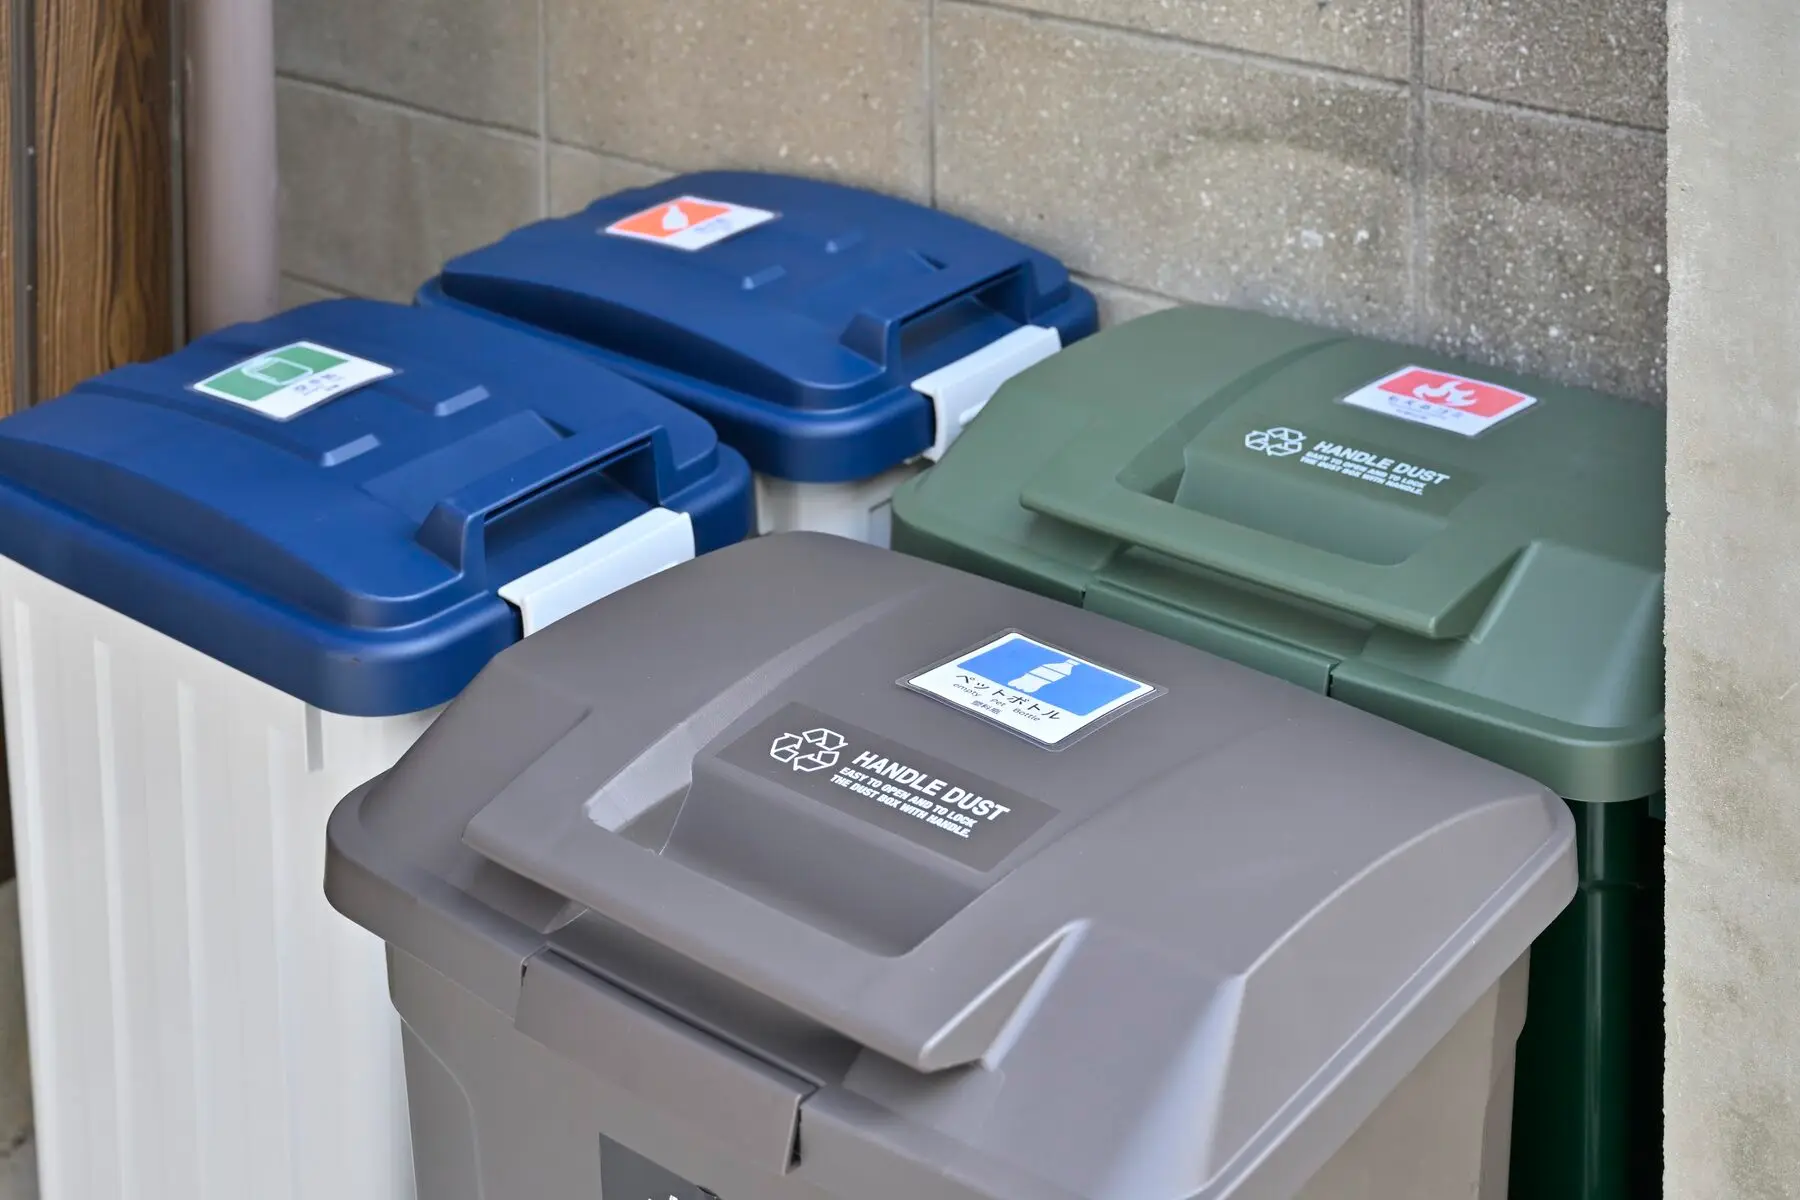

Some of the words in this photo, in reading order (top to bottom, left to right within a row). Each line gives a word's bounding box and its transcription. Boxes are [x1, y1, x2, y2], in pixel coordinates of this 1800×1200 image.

[1313, 440, 1395, 471] HANDLE
[1392, 462, 1451, 485] DUST
[953, 683, 983, 697] empty
[1012, 707, 1040, 721] Bottle
[956, 675, 1060, 720] ペットボトル
[830, 774, 853, 788] THE
[849, 783, 880, 798] DUST
[876, 793, 902, 808] BOX
[900, 803, 929, 819] WITH
[926, 814, 971, 838] HANDLE.
[839, 766, 869, 782] EASY
[867, 777, 883, 788] TO
[881, 784, 911, 800] OPEN
[908, 795, 934, 809] AND
[932, 804, 949, 815] TO
[947, 811, 978, 828] LOCK
[852, 750, 948, 796] HANDLE
[940, 786, 1011, 821] DUST
